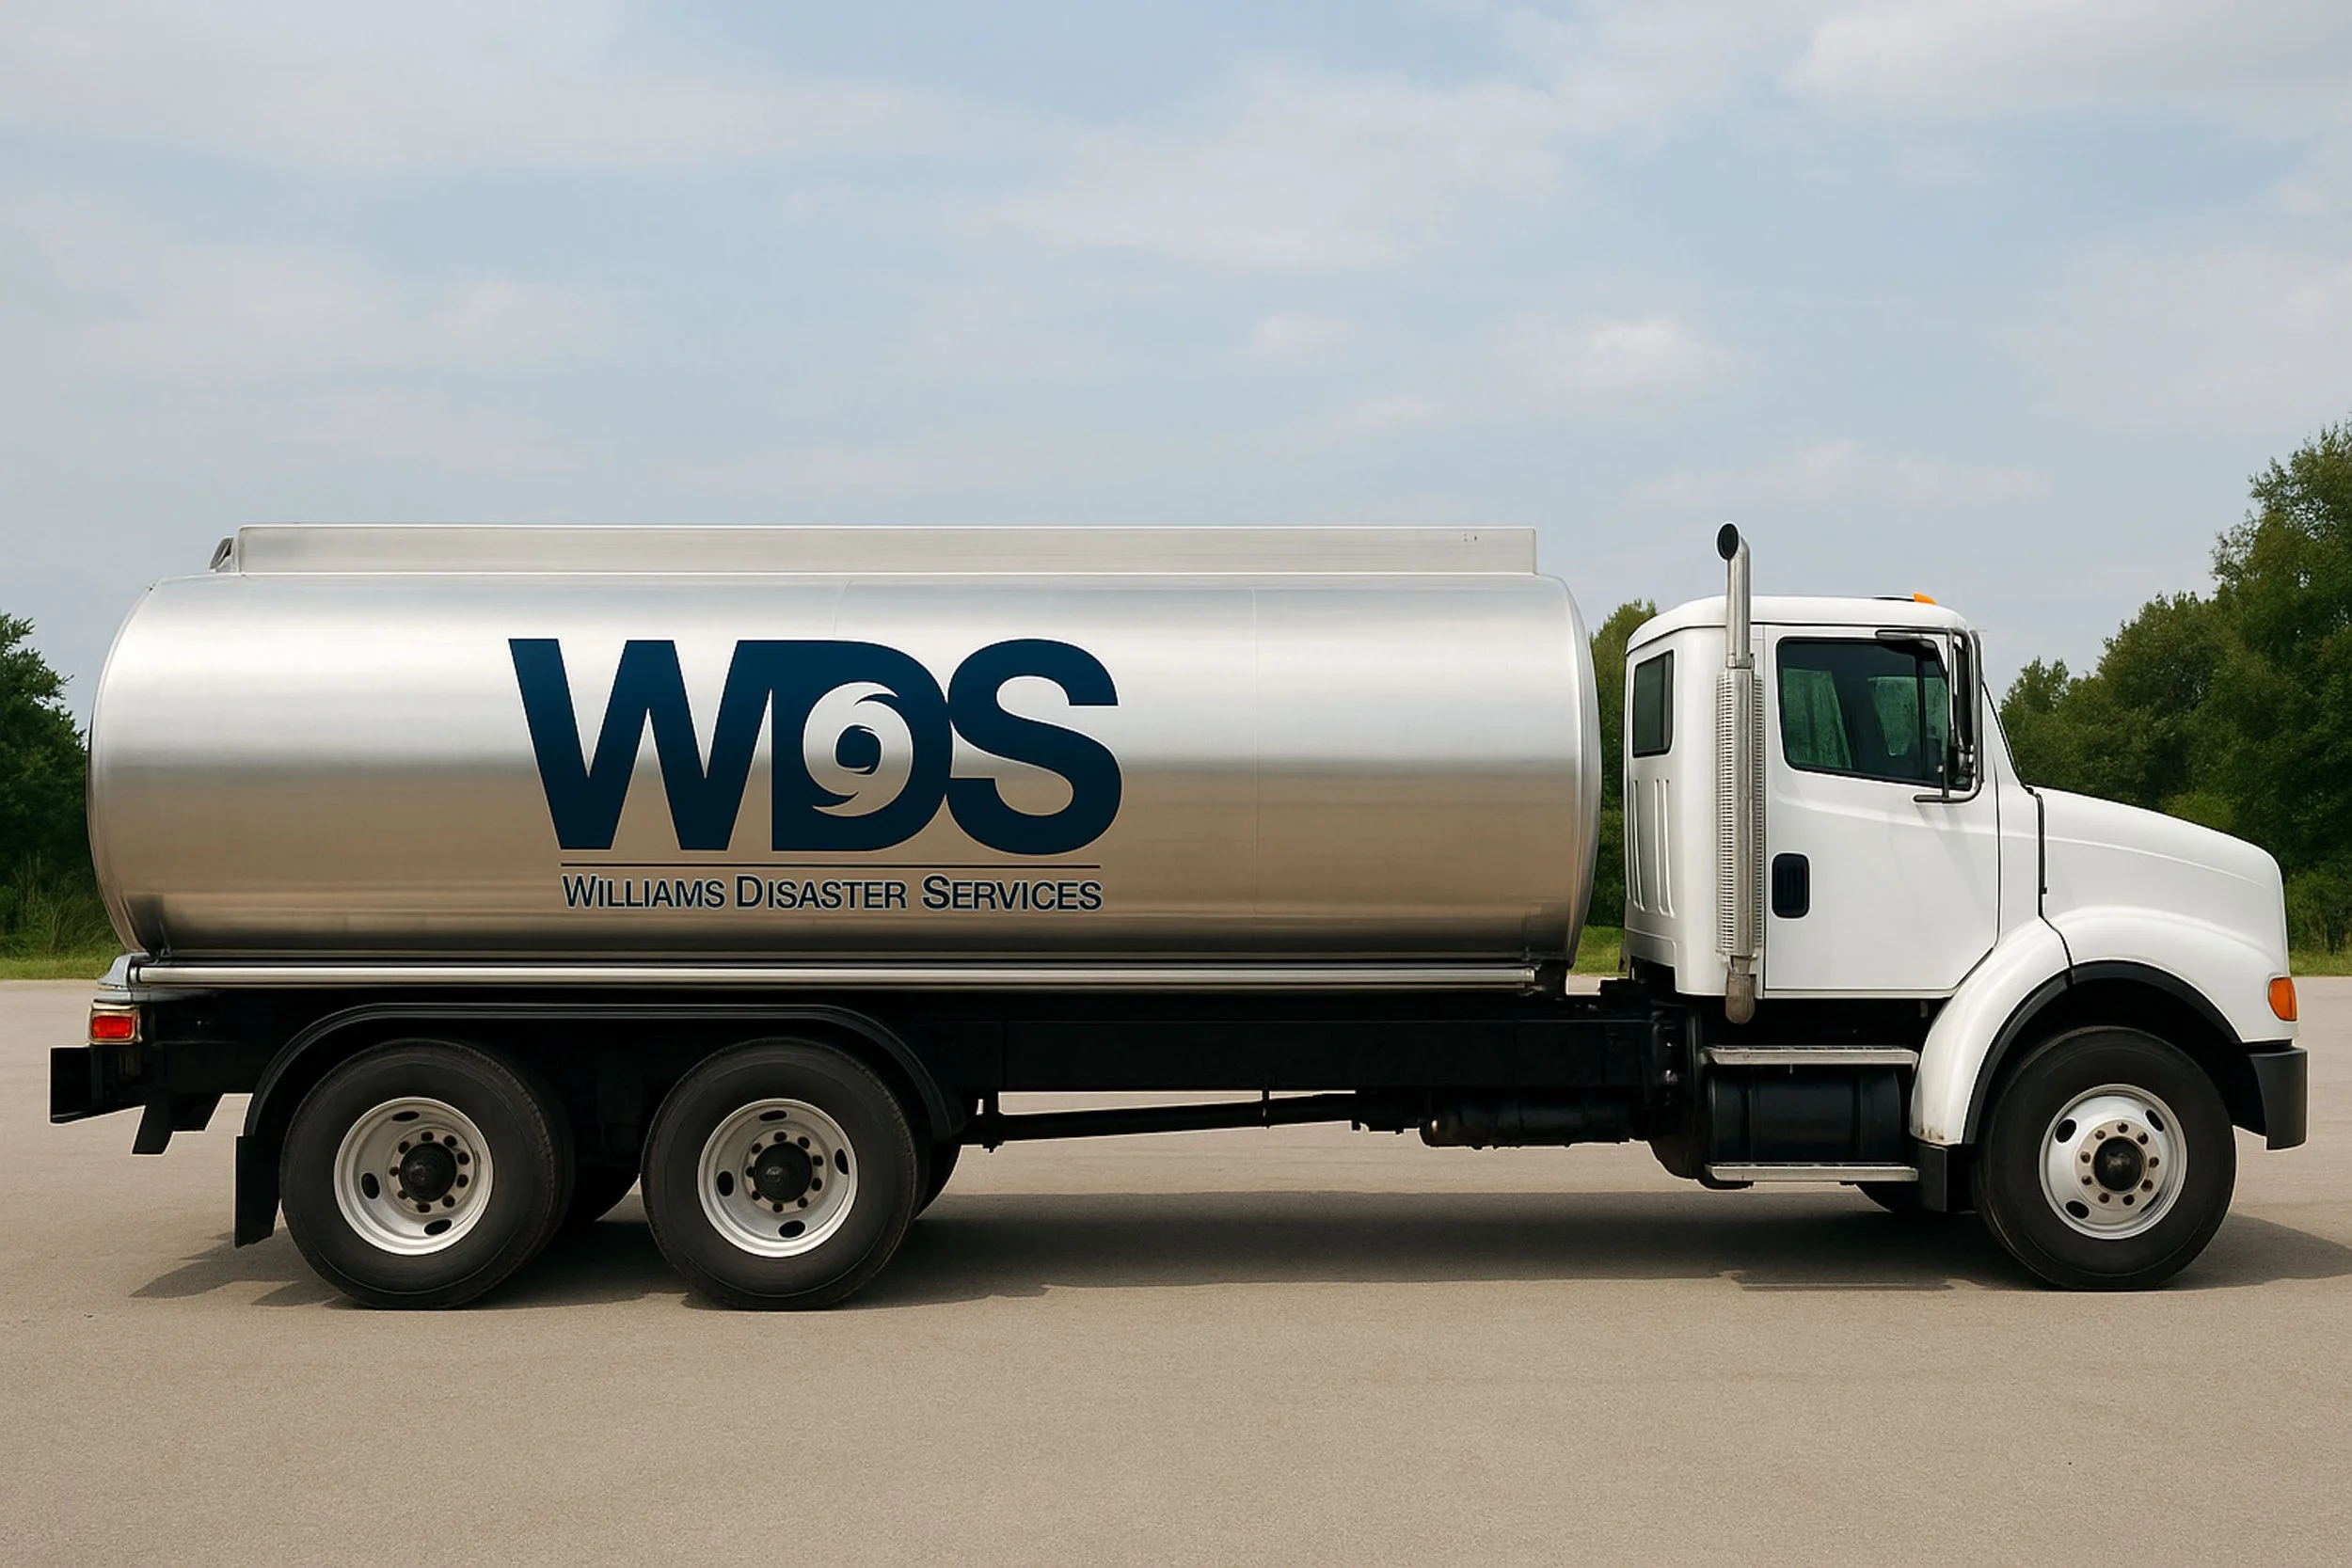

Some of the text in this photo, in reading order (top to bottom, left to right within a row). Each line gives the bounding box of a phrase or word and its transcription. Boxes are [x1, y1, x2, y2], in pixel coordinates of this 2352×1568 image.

[508, 638, 1122, 856] WDS
[563, 875, 1102, 911] WILLIAMS DISASTER SERVICES
